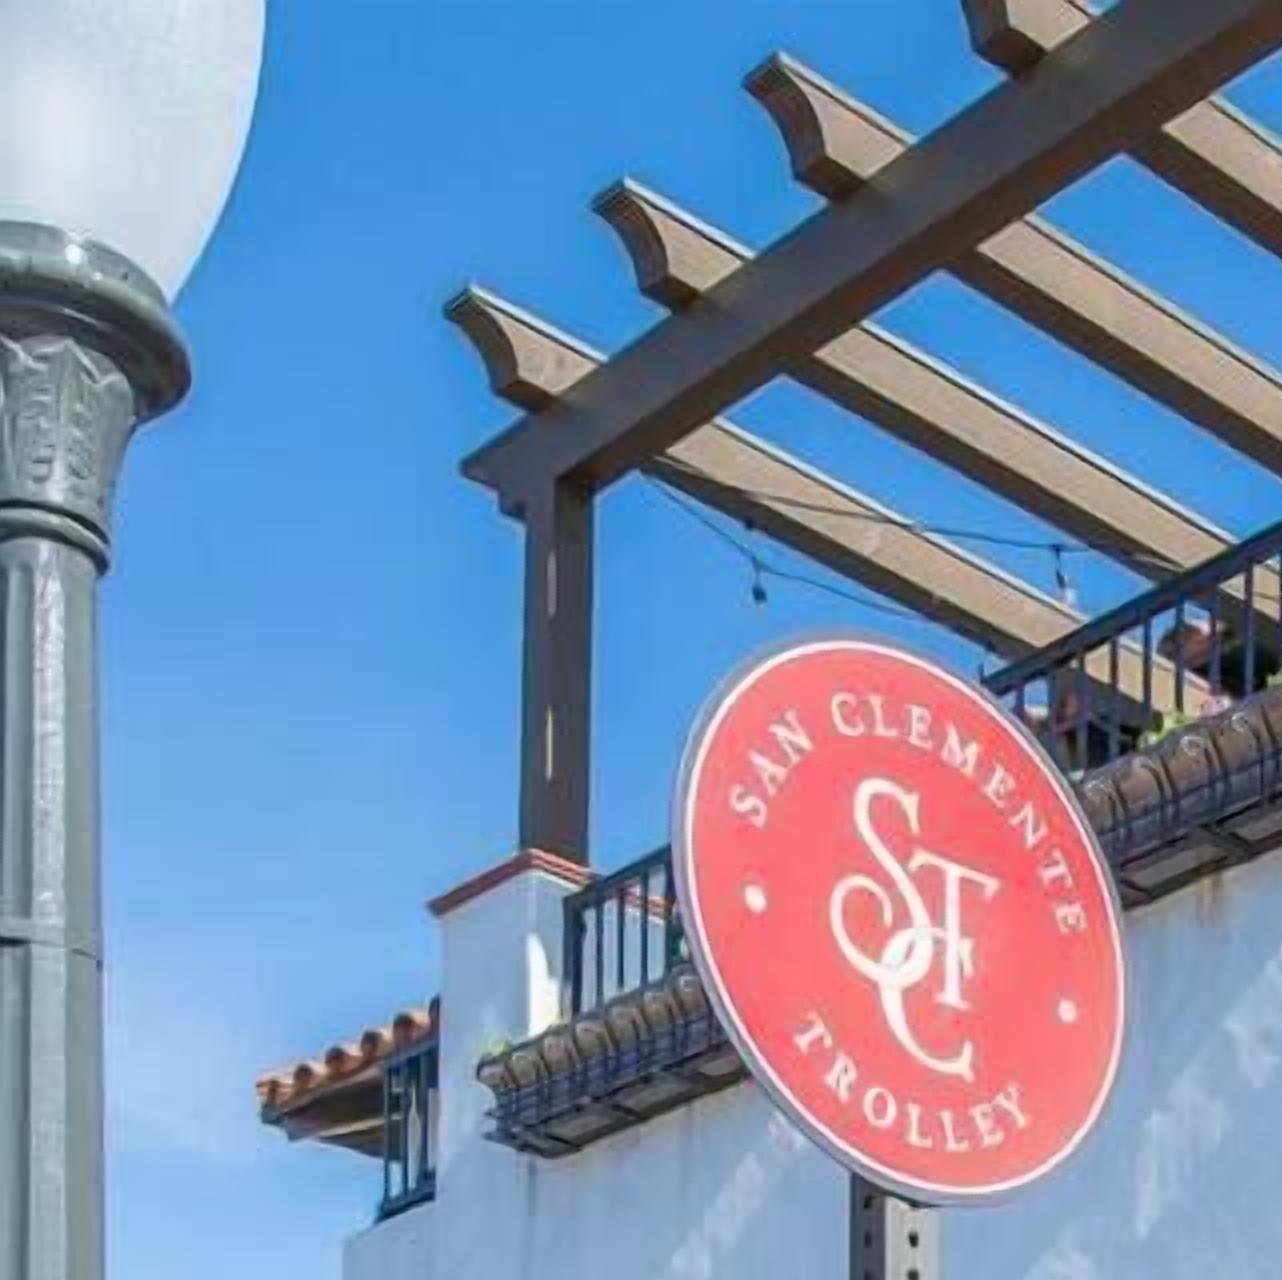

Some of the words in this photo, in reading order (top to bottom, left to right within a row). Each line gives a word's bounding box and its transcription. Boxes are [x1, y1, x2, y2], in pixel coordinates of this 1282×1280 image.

[730, 711, 815, 827] SAN
[831, 692, 1086, 934] CLEMENTE
[795, 1012, 1028, 1152] TROLLEY
